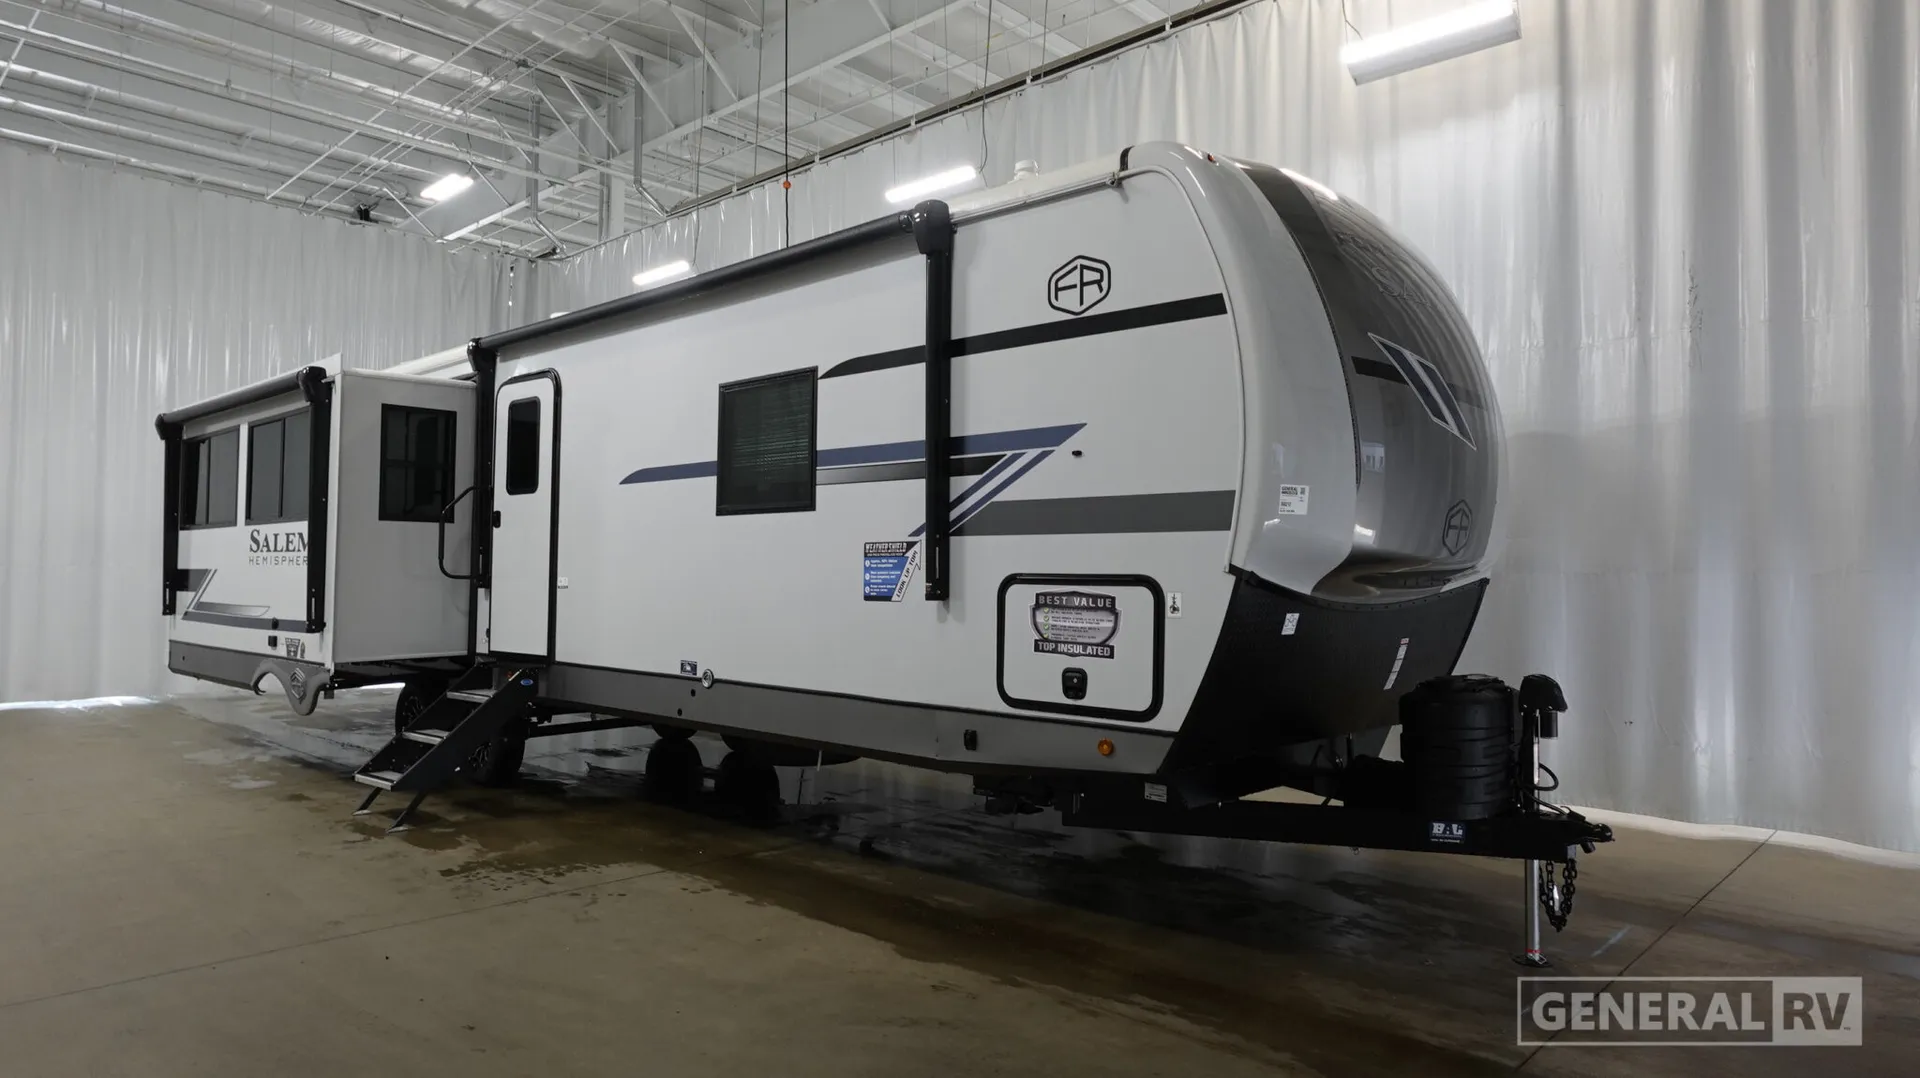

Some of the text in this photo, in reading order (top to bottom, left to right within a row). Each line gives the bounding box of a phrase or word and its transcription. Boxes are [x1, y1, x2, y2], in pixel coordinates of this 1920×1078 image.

[1054, 263, 1104, 307] FR
[249, 528, 309, 553] SALEM
[248, 555, 309, 566] HEMISPHER
[1038, 594, 1112, 608] BEST VALUE
[1037, 641, 1111, 656] TOP INSULATED
